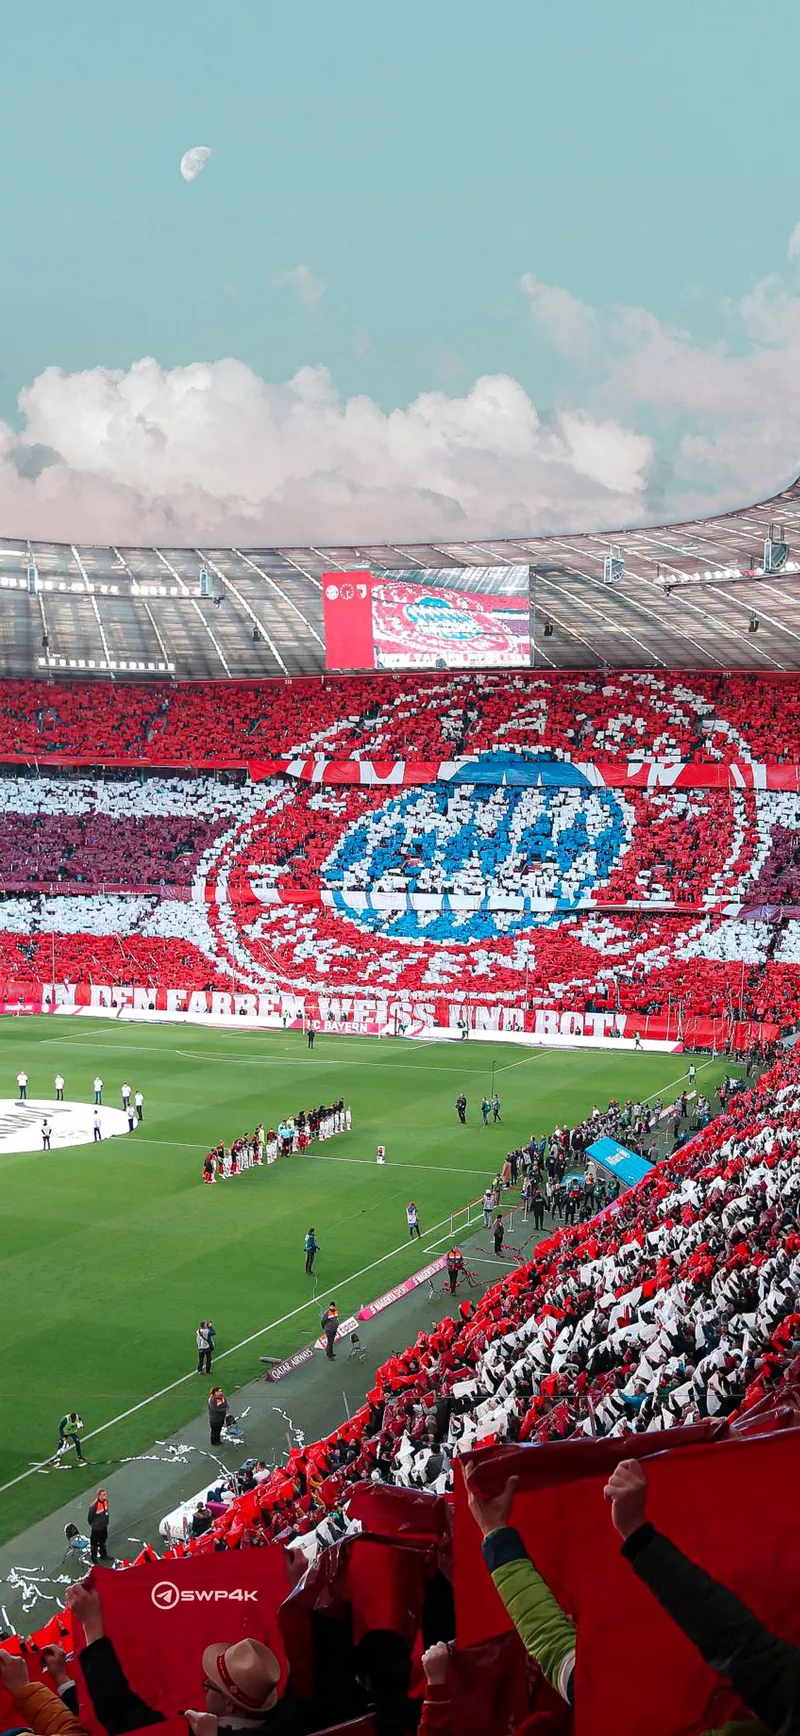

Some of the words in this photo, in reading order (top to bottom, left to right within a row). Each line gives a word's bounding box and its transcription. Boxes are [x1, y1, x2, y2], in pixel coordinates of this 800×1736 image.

[91, 984, 158, 1010] DEN
[166, 988, 305, 1019] FARBEN
[318, 997, 438, 1027] WEISS
[449, 1004, 525, 1033] UND
[535, 1009, 627, 1039] ROT!
[324, 1020, 368, 1033] BAYERN
[271, 1361, 292, 1379] QATAR
[290, 1347, 313, 1368] AIRWAYS
